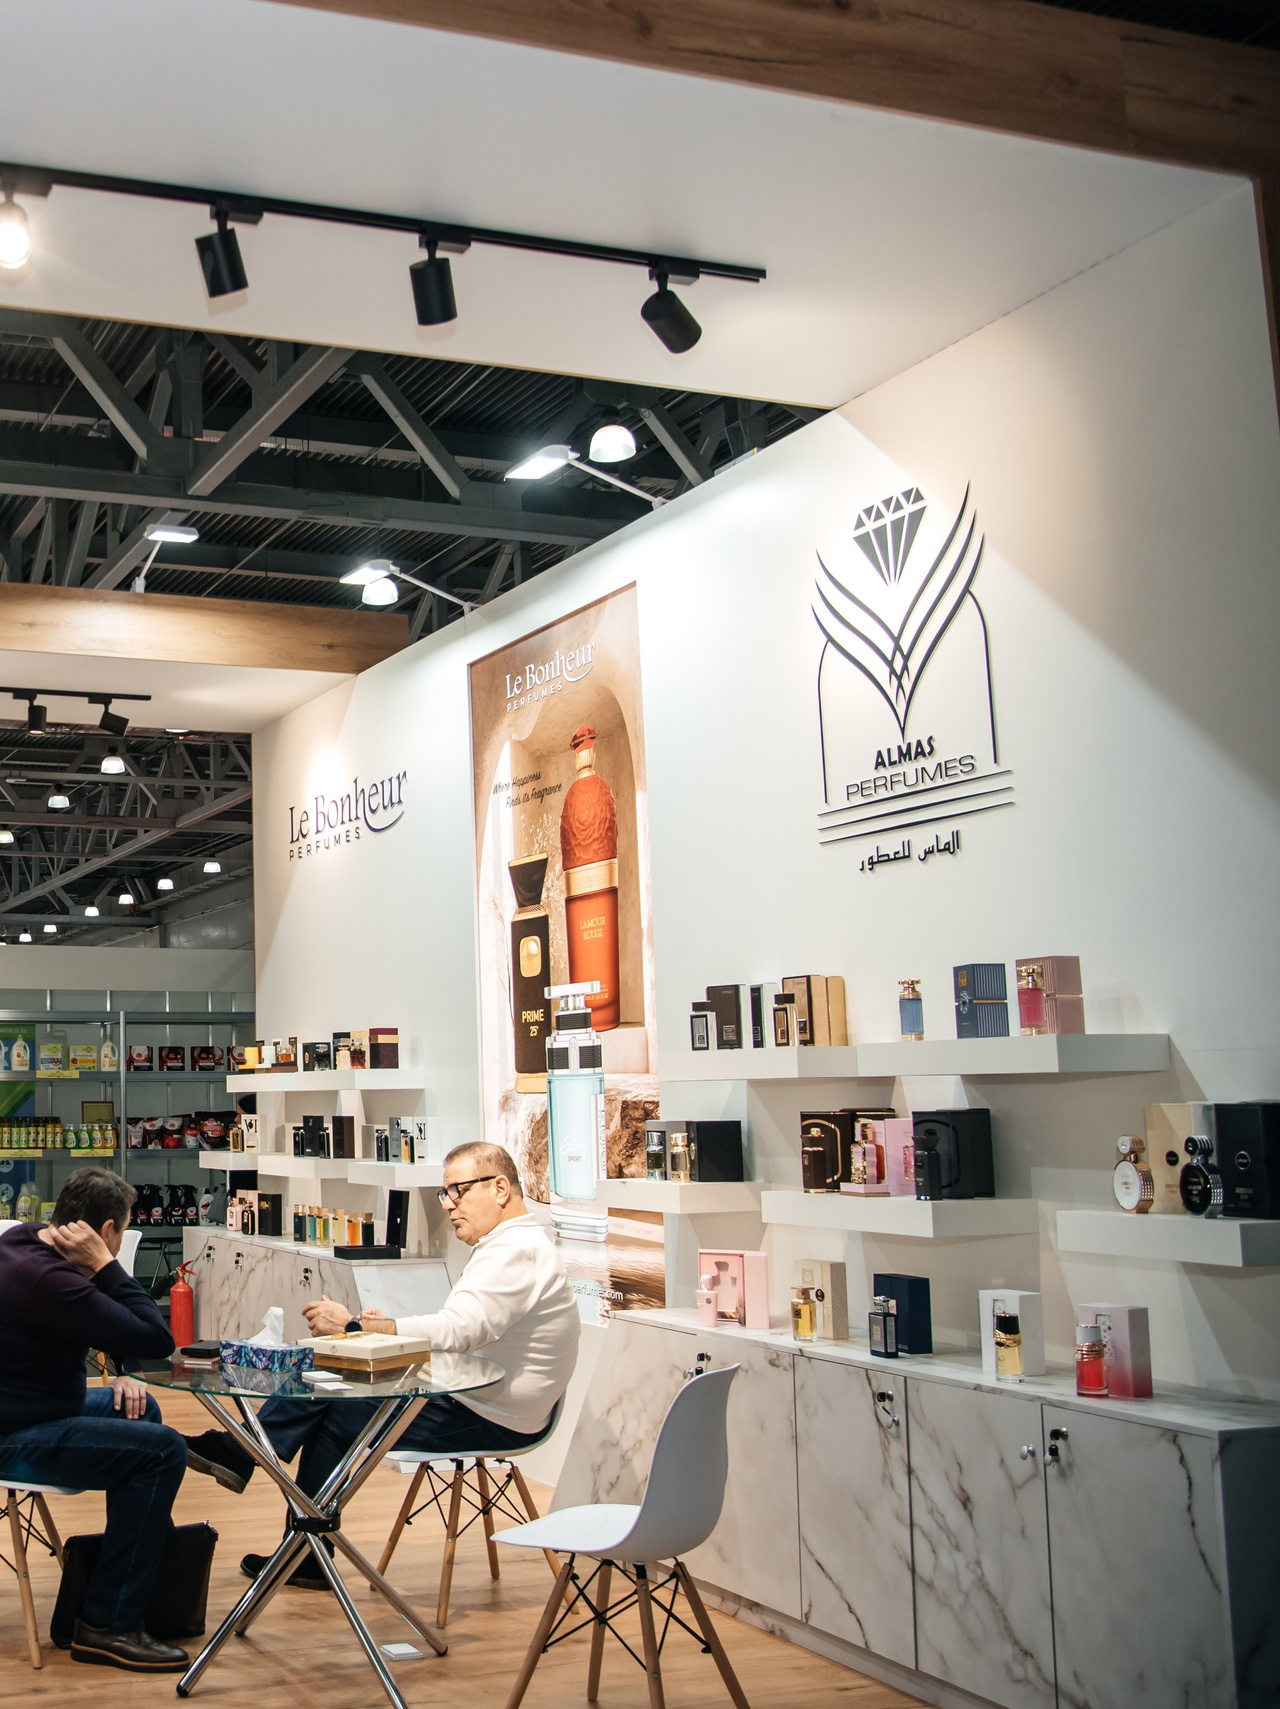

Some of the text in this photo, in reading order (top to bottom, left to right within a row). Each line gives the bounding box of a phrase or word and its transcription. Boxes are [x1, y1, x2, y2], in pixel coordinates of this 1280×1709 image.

[505, 642, 596, 699] Le Bonheur
[506, 681, 562, 712] PERFUMES
[874, 735, 935, 771] ALMAS
[531, 783, 562, 804] Fragrance
[846, 754, 976, 801] PERFUMES
[289, 770, 408, 844] Le Bonheur
[289, 827, 361, 861] PERFUMES
[859, 829, 960, 871] الماس للعطور
[580, 916, 605, 929] LAMOUR
[583, 928, 603, 940] ROUGE
[522, 1009, 544, 1023] PRIME
